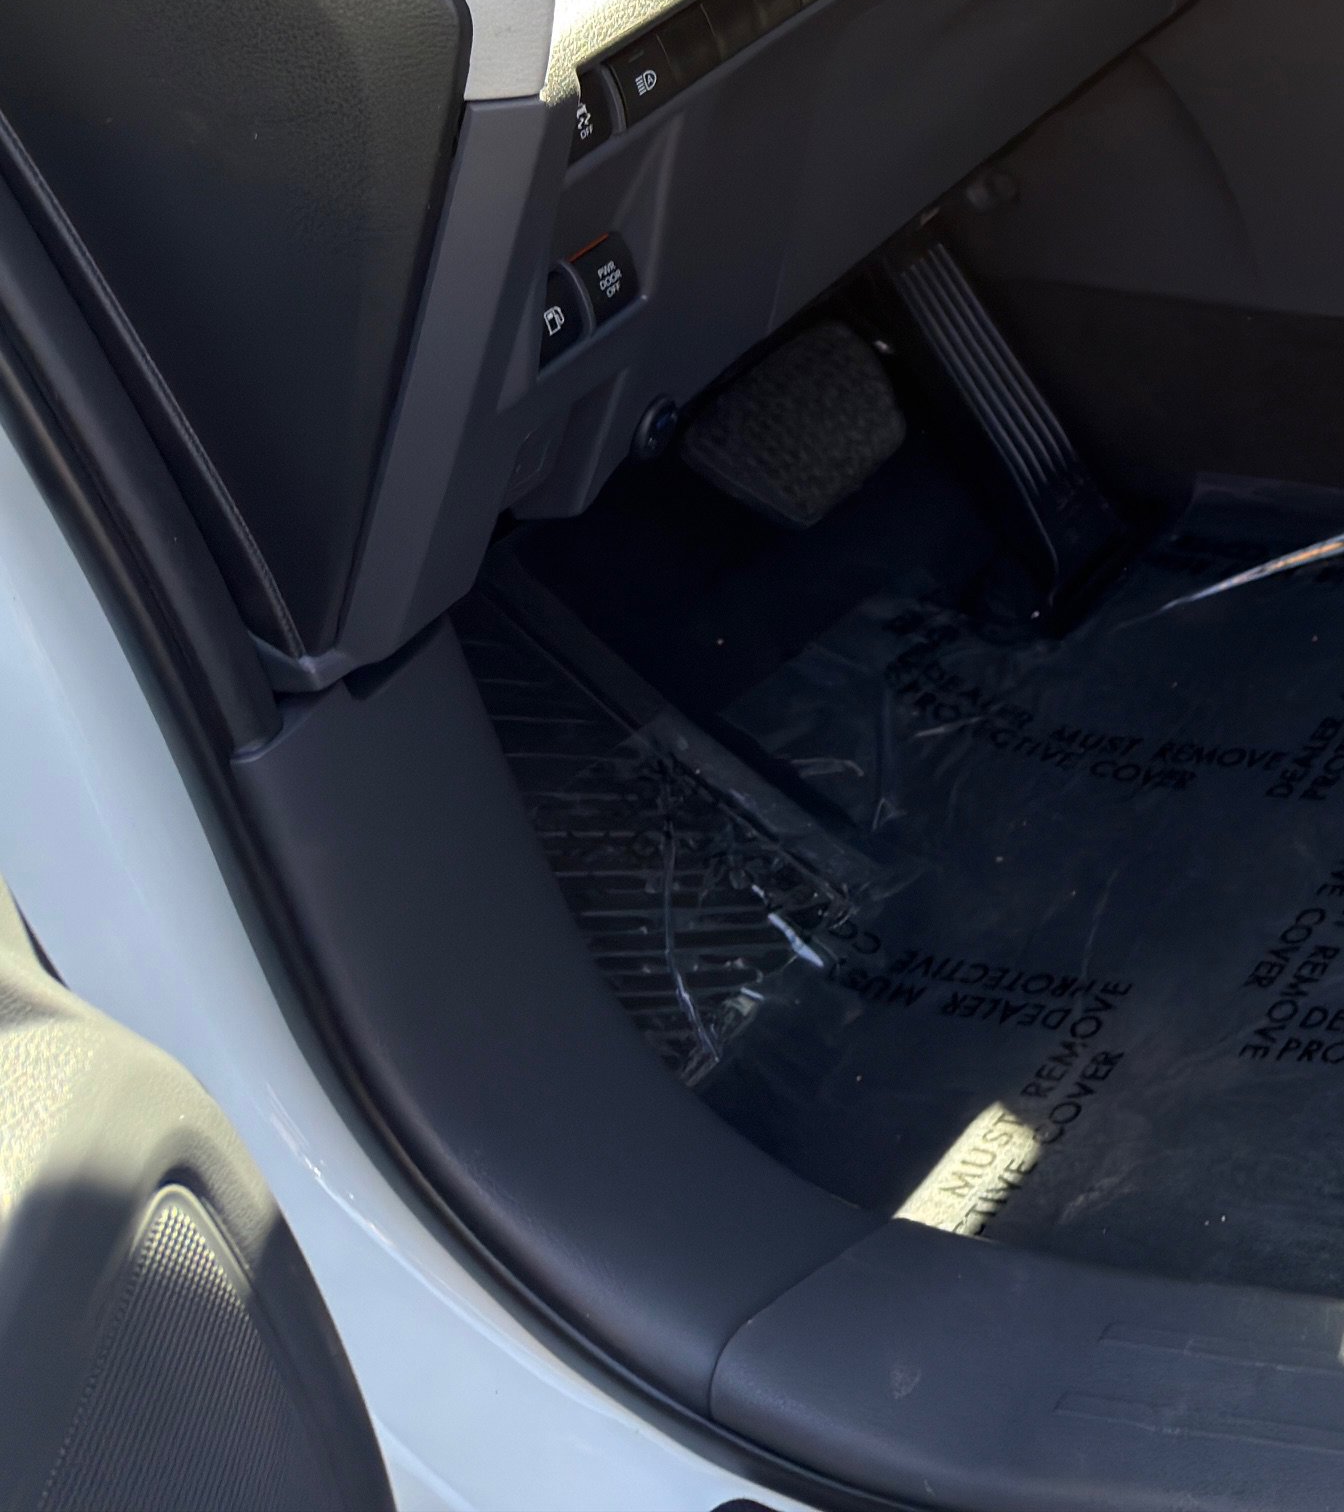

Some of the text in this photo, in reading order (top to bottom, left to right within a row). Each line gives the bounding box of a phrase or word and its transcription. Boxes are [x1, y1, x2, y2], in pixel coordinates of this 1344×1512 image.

[579, 124, 595, 140] OFF
[597, 259, 618, 279] PWR
[599, 270, 624, 291] DOOR
[606, 281, 622, 298] OFF
[1049, 726, 1143, 760] MUST
[1151, 741, 1287, 771] REMOVE
[1089, 758, 1198, 792] COVER
[1244, 907, 1327, 989] COVER
[941, 990, 1073, 1030] DEALER
[1238, 944, 1341, 1060] REMOVE
[937, 1112, 1022, 1198] MUST
[1020, 983, 1133, 1099] REMOVE
[1034, 1050, 1125, 1144] COVER
